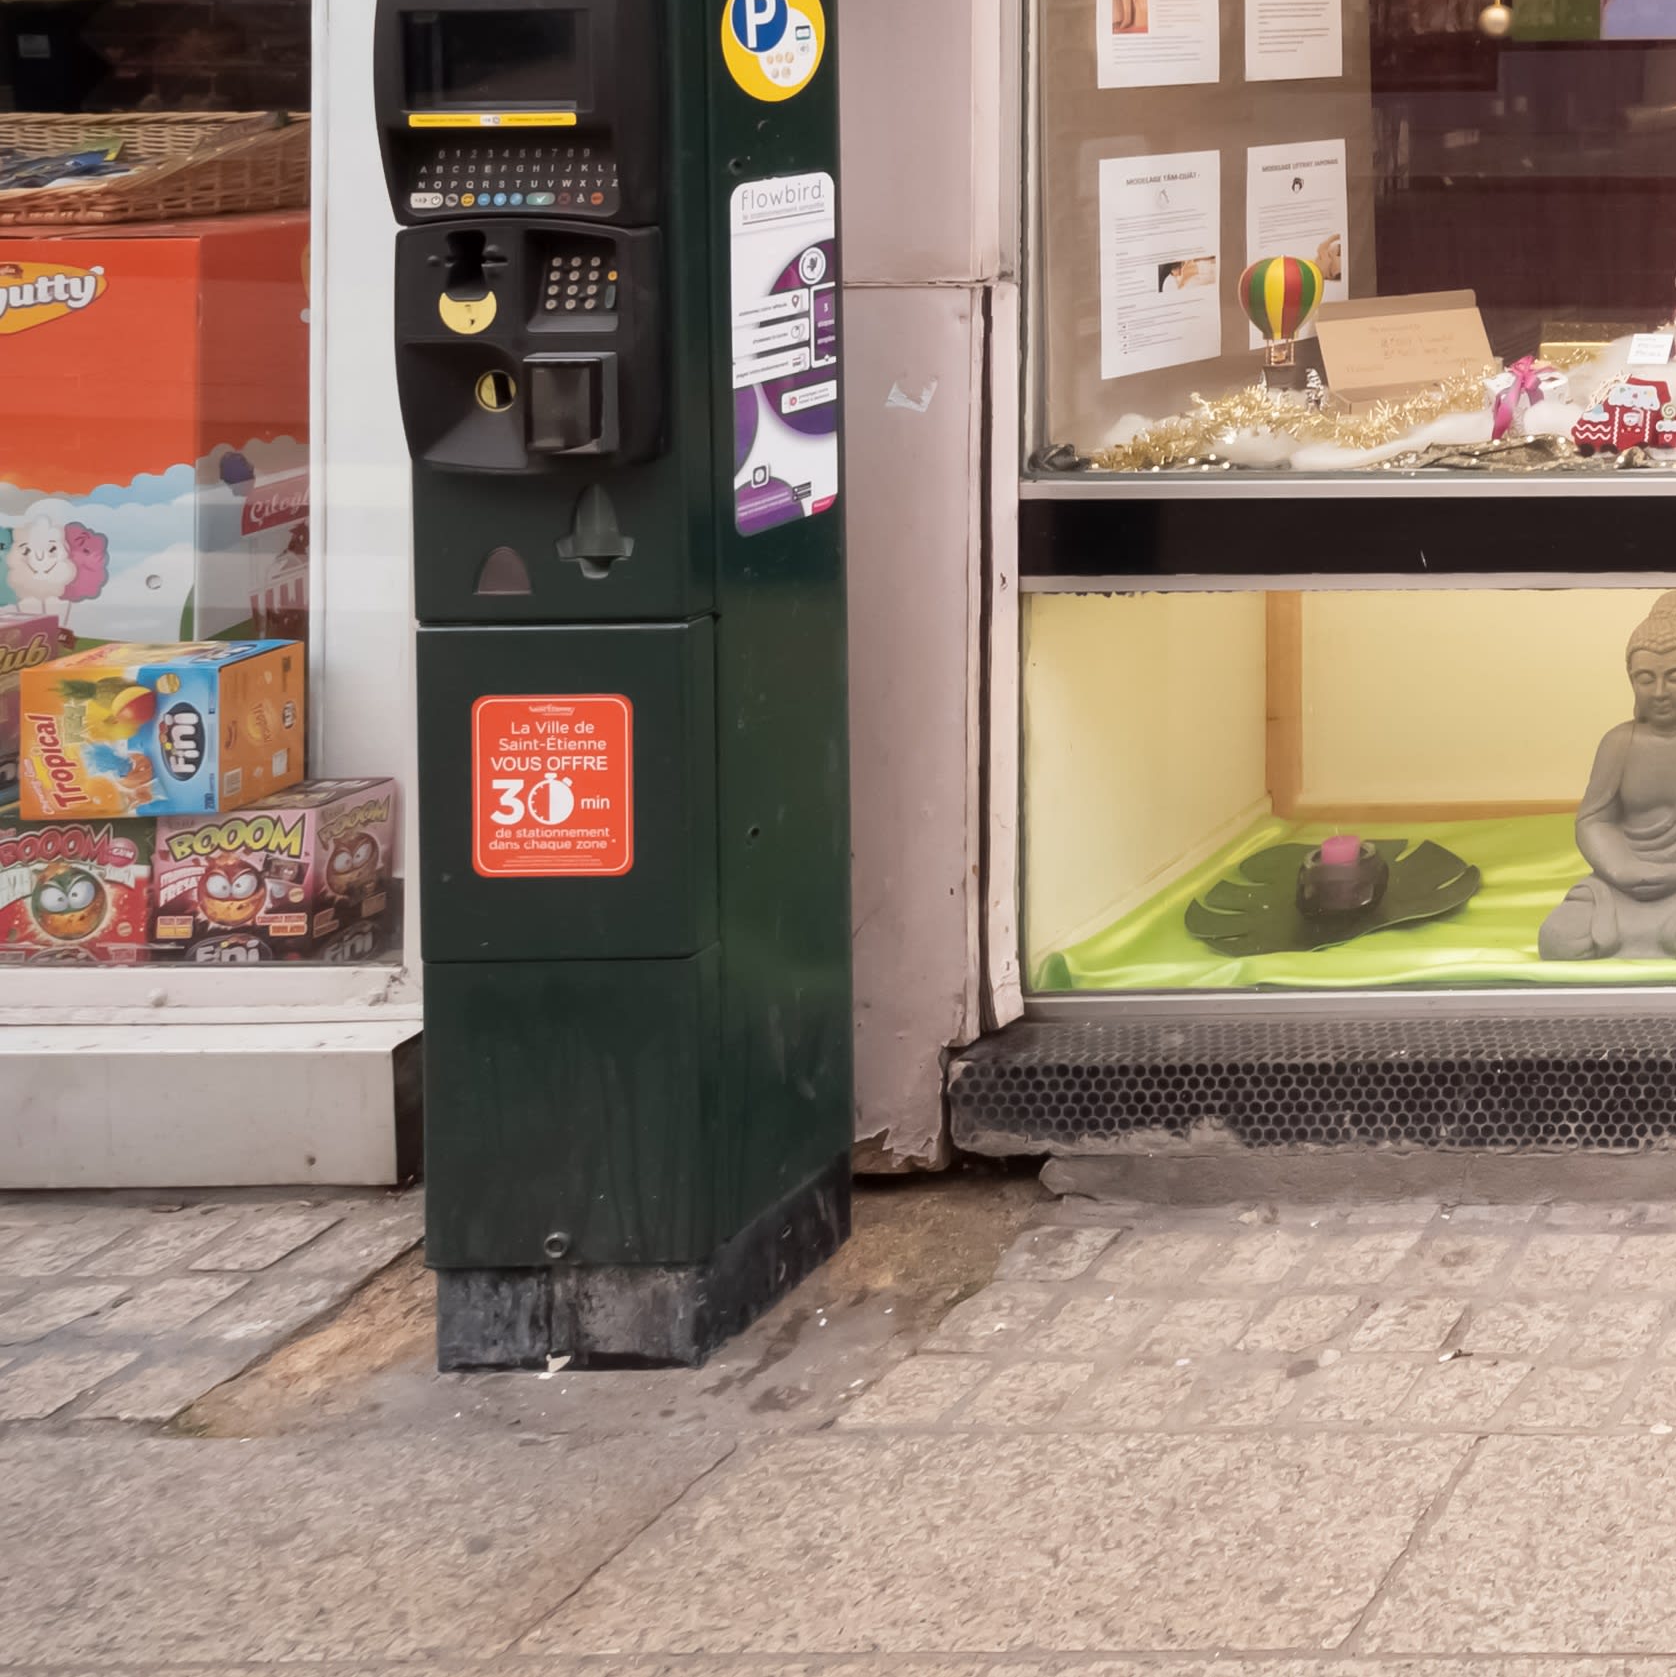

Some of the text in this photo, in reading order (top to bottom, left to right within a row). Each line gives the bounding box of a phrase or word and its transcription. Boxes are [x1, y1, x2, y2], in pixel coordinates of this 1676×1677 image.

[511, 720, 594, 735] La Ville de
[164, 711, 199, 775] Fini
[498, 735, 607, 752] Saint-Étienne
[24, 713, 88, 810] Tropical
[490, 756, 608, 772] VOUS OFFRE
[580, 795, 610, 810] min
[165, 813, 306, 862] BOOOM
[495, 827, 610, 839] de stationnement
[488, 838, 608, 853] dans chaque zone
